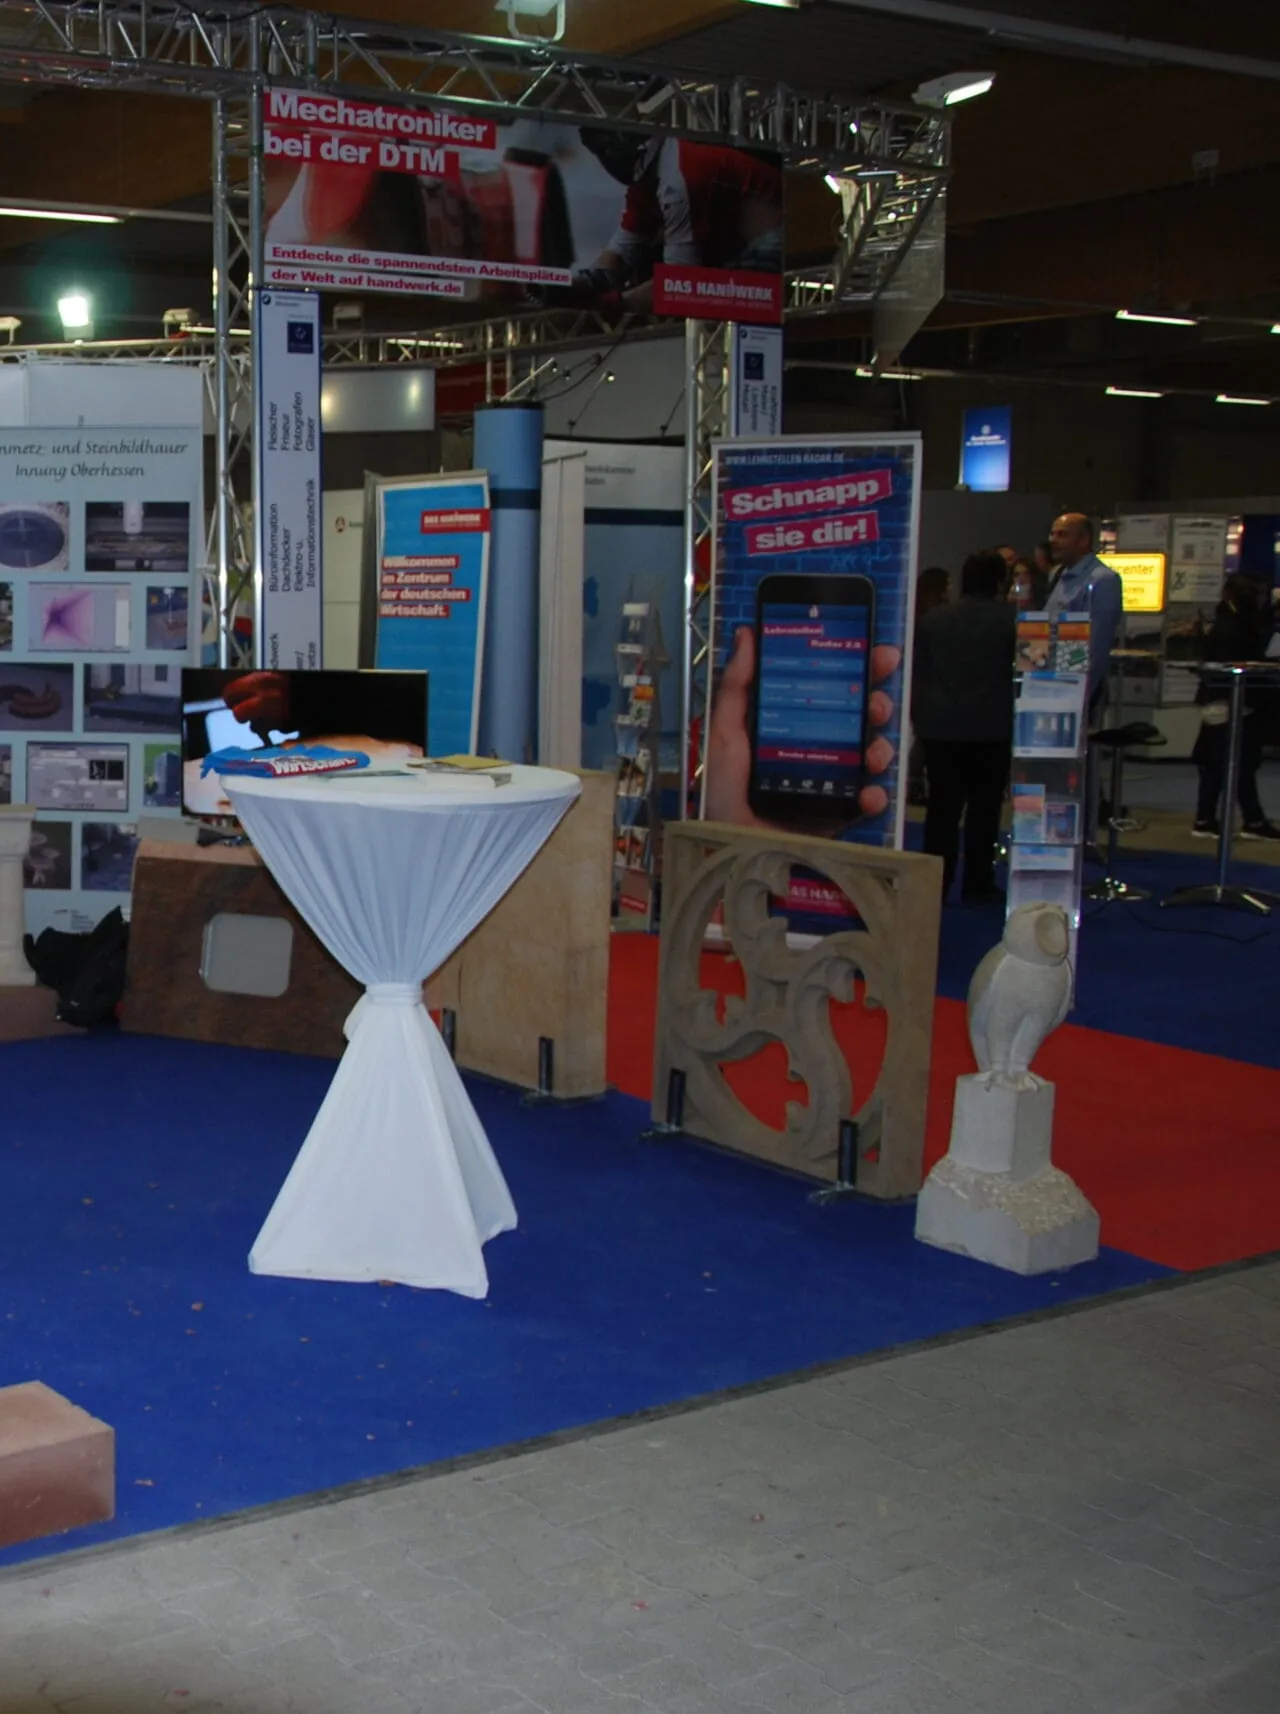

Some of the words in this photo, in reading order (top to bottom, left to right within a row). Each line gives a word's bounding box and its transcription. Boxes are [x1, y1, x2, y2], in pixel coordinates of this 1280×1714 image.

[270, 92, 488, 141] Mechatroniker
[263, 129, 311, 158] bei
[320, 135, 372, 164] der
[379, 142, 446, 173] DTM
[272, 247, 343, 263] Entdecke
[347, 253, 370, 265] die
[374, 257, 476, 275] spannendsten
[479, 264, 570, 283] Arbeitsplätze
[272, 269, 296, 281] der
[301, 271, 335, 284] Welt
[339, 274, 363, 287] auf
[367, 278, 462, 294] handwerk.de
[663, 278, 692, 294] DAS
[696, 279, 773, 300] HANDWERK
[293, 391, 304, 451] Fotografen
[306, 415, 315, 451] Glaser
[52, 440, 81, 455] und
[85, 439, 189, 455] Steinbildhauer
[15, 464, 68, 482] Innung
[70, 463, 146, 477] Oberhessen
[731, 479, 879, 515] Schnapp
[306, 479, 316, 588] Informationstechnik
[756, 526, 805, 549] sie
[812, 518, 867, 545] dir!
[282, 528, 290, 592] Dachdecker
[397, 572, 450, 584] Zentrum
[400, 588, 466, 600] deutschen
